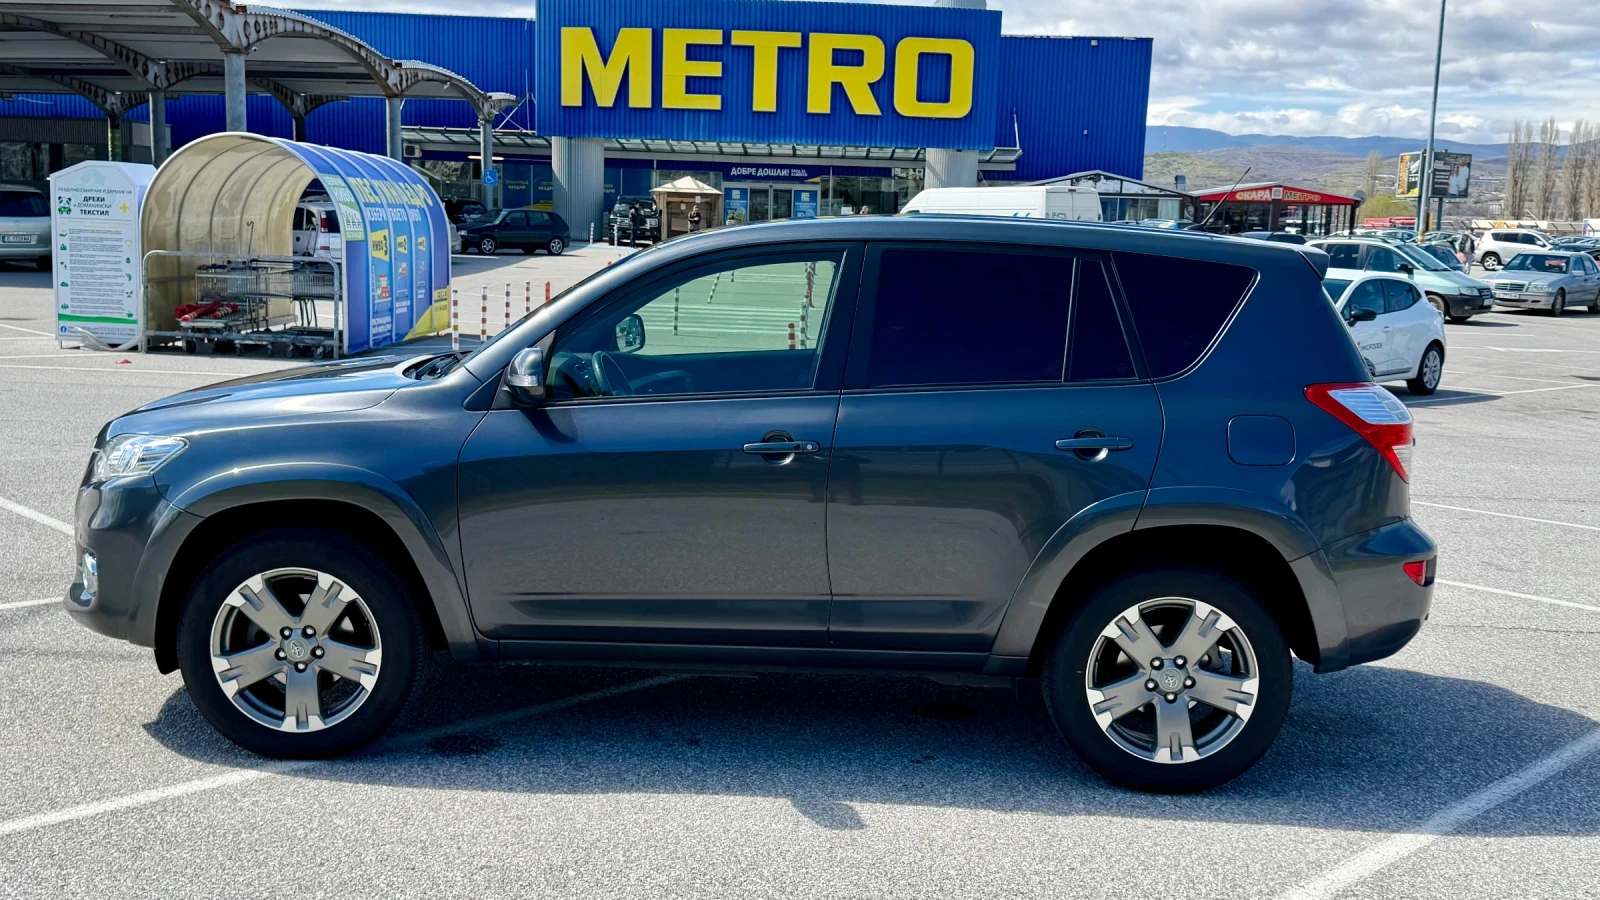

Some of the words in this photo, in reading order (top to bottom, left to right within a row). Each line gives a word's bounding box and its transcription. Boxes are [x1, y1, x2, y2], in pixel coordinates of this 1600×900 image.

[560, 27, 975, 118] METRO
[730, 167, 757, 176] ДОБРЕ
[757, 168, 790, 177] ДОШЛИ!
[1236, 189, 1272, 200] СКАРА
[1284, 190, 1321, 201] МЕТРО
[383, 235, 388, 256] 3
